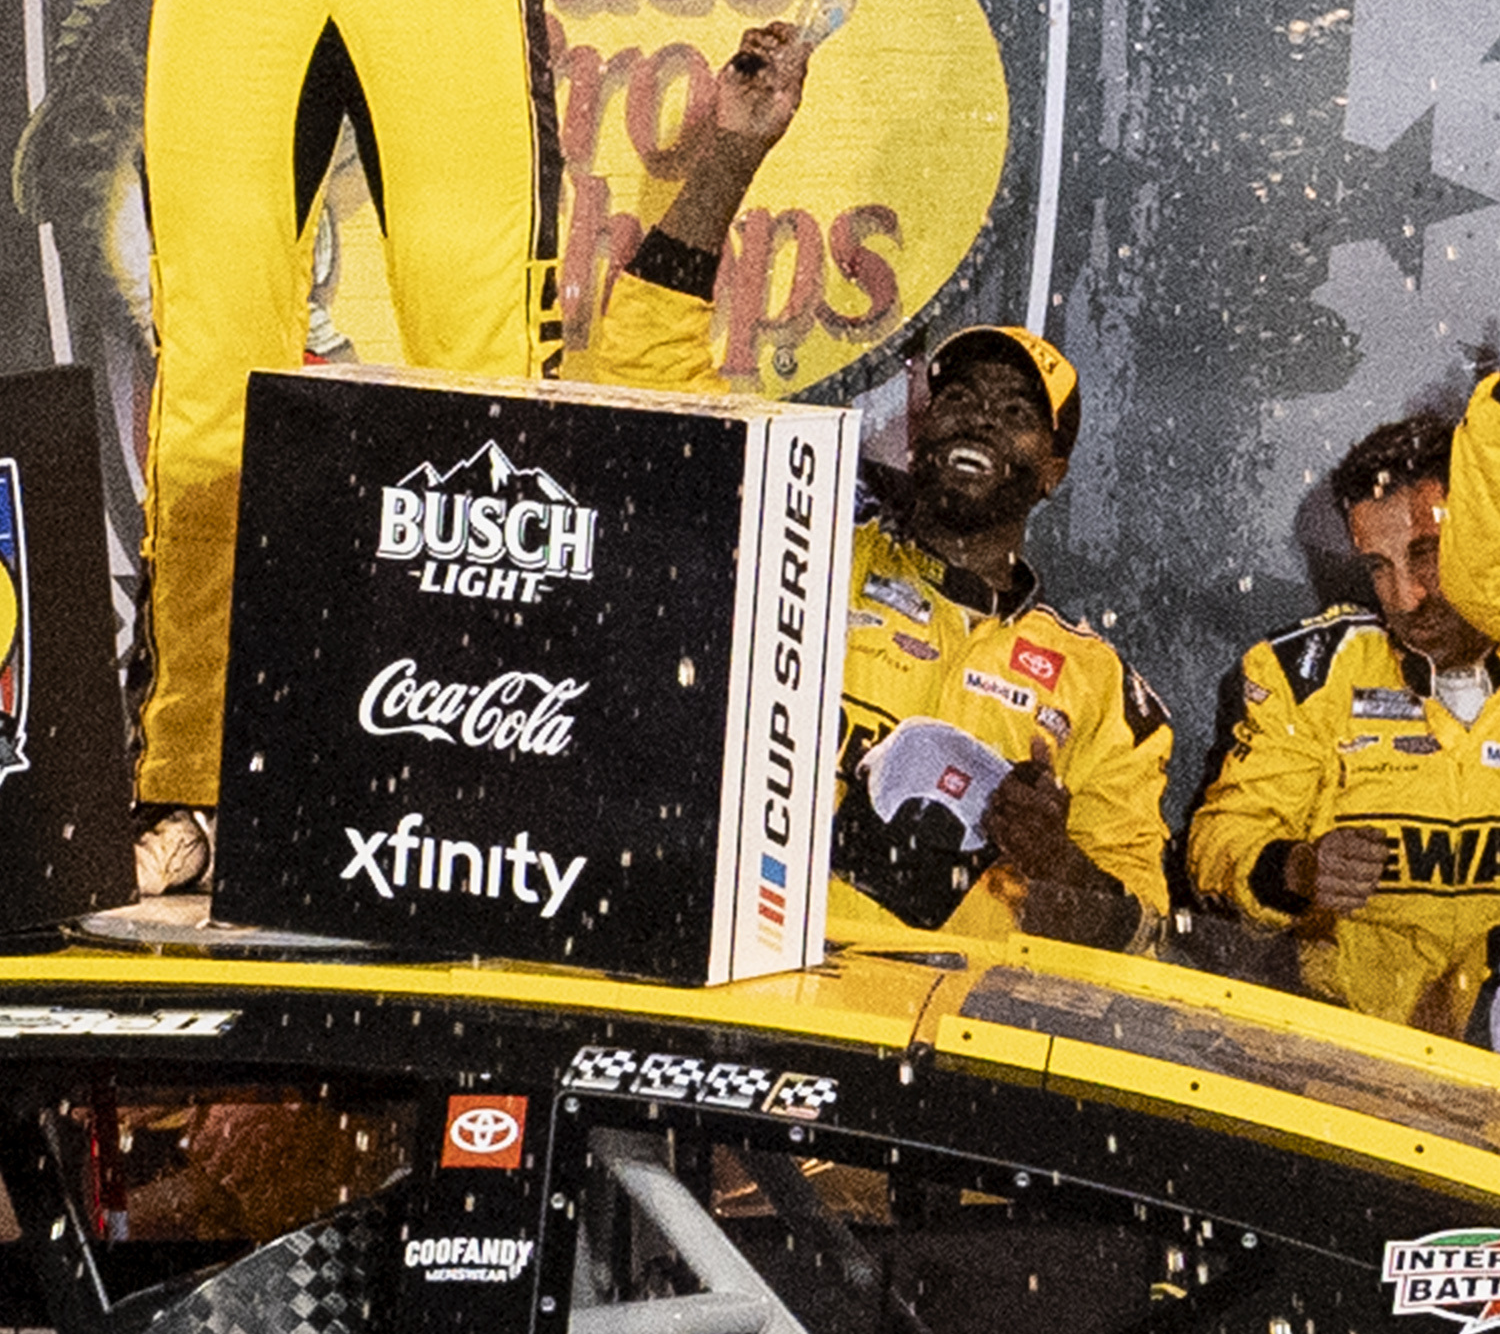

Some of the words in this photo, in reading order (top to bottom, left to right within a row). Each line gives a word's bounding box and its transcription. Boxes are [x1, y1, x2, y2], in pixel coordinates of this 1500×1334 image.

[546, 13, 718, 175] ro
[376, 486, 598, 580] BUSCH
[419, 561, 542, 603] LIGHT
[775, 435, 817, 693] SERIES
[359, 659, 588, 756] Coca-Cola
[761, 705, 795, 846] CUP
[340, 813, 587, 917] xfinity
[404, 1236, 535, 1275] COOFANDY
